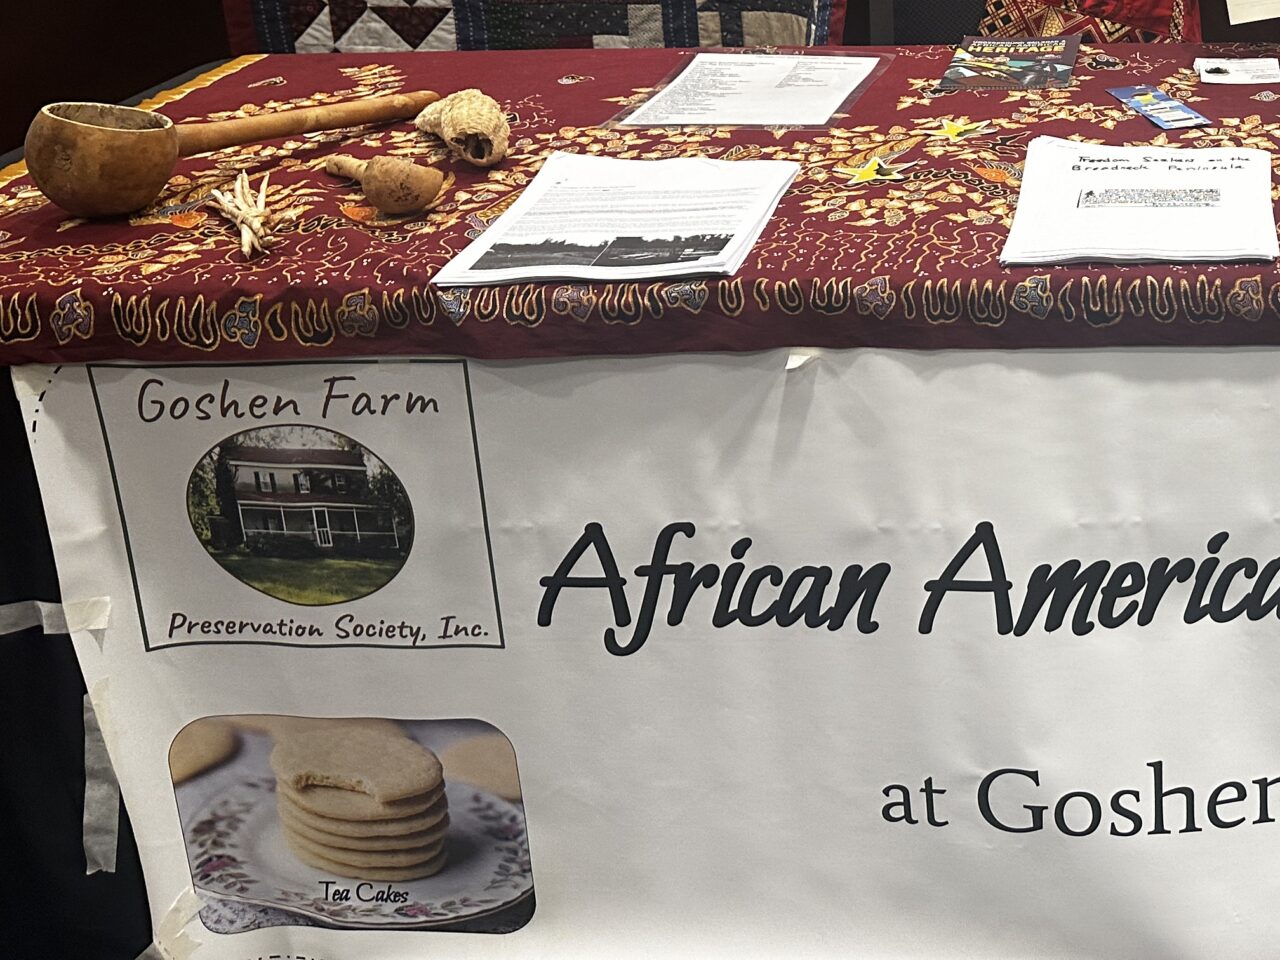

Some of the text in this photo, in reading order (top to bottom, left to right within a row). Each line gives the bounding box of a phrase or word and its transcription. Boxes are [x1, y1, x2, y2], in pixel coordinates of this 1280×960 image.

[138, 376, 439, 423] Goshen Farm
[538, 522, 892, 656] African
[169, 612, 489, 647] Preservation Society, Inc.
[882, 777, 948, 827] at
[318, 880, 410, 904] Tea Cakes
